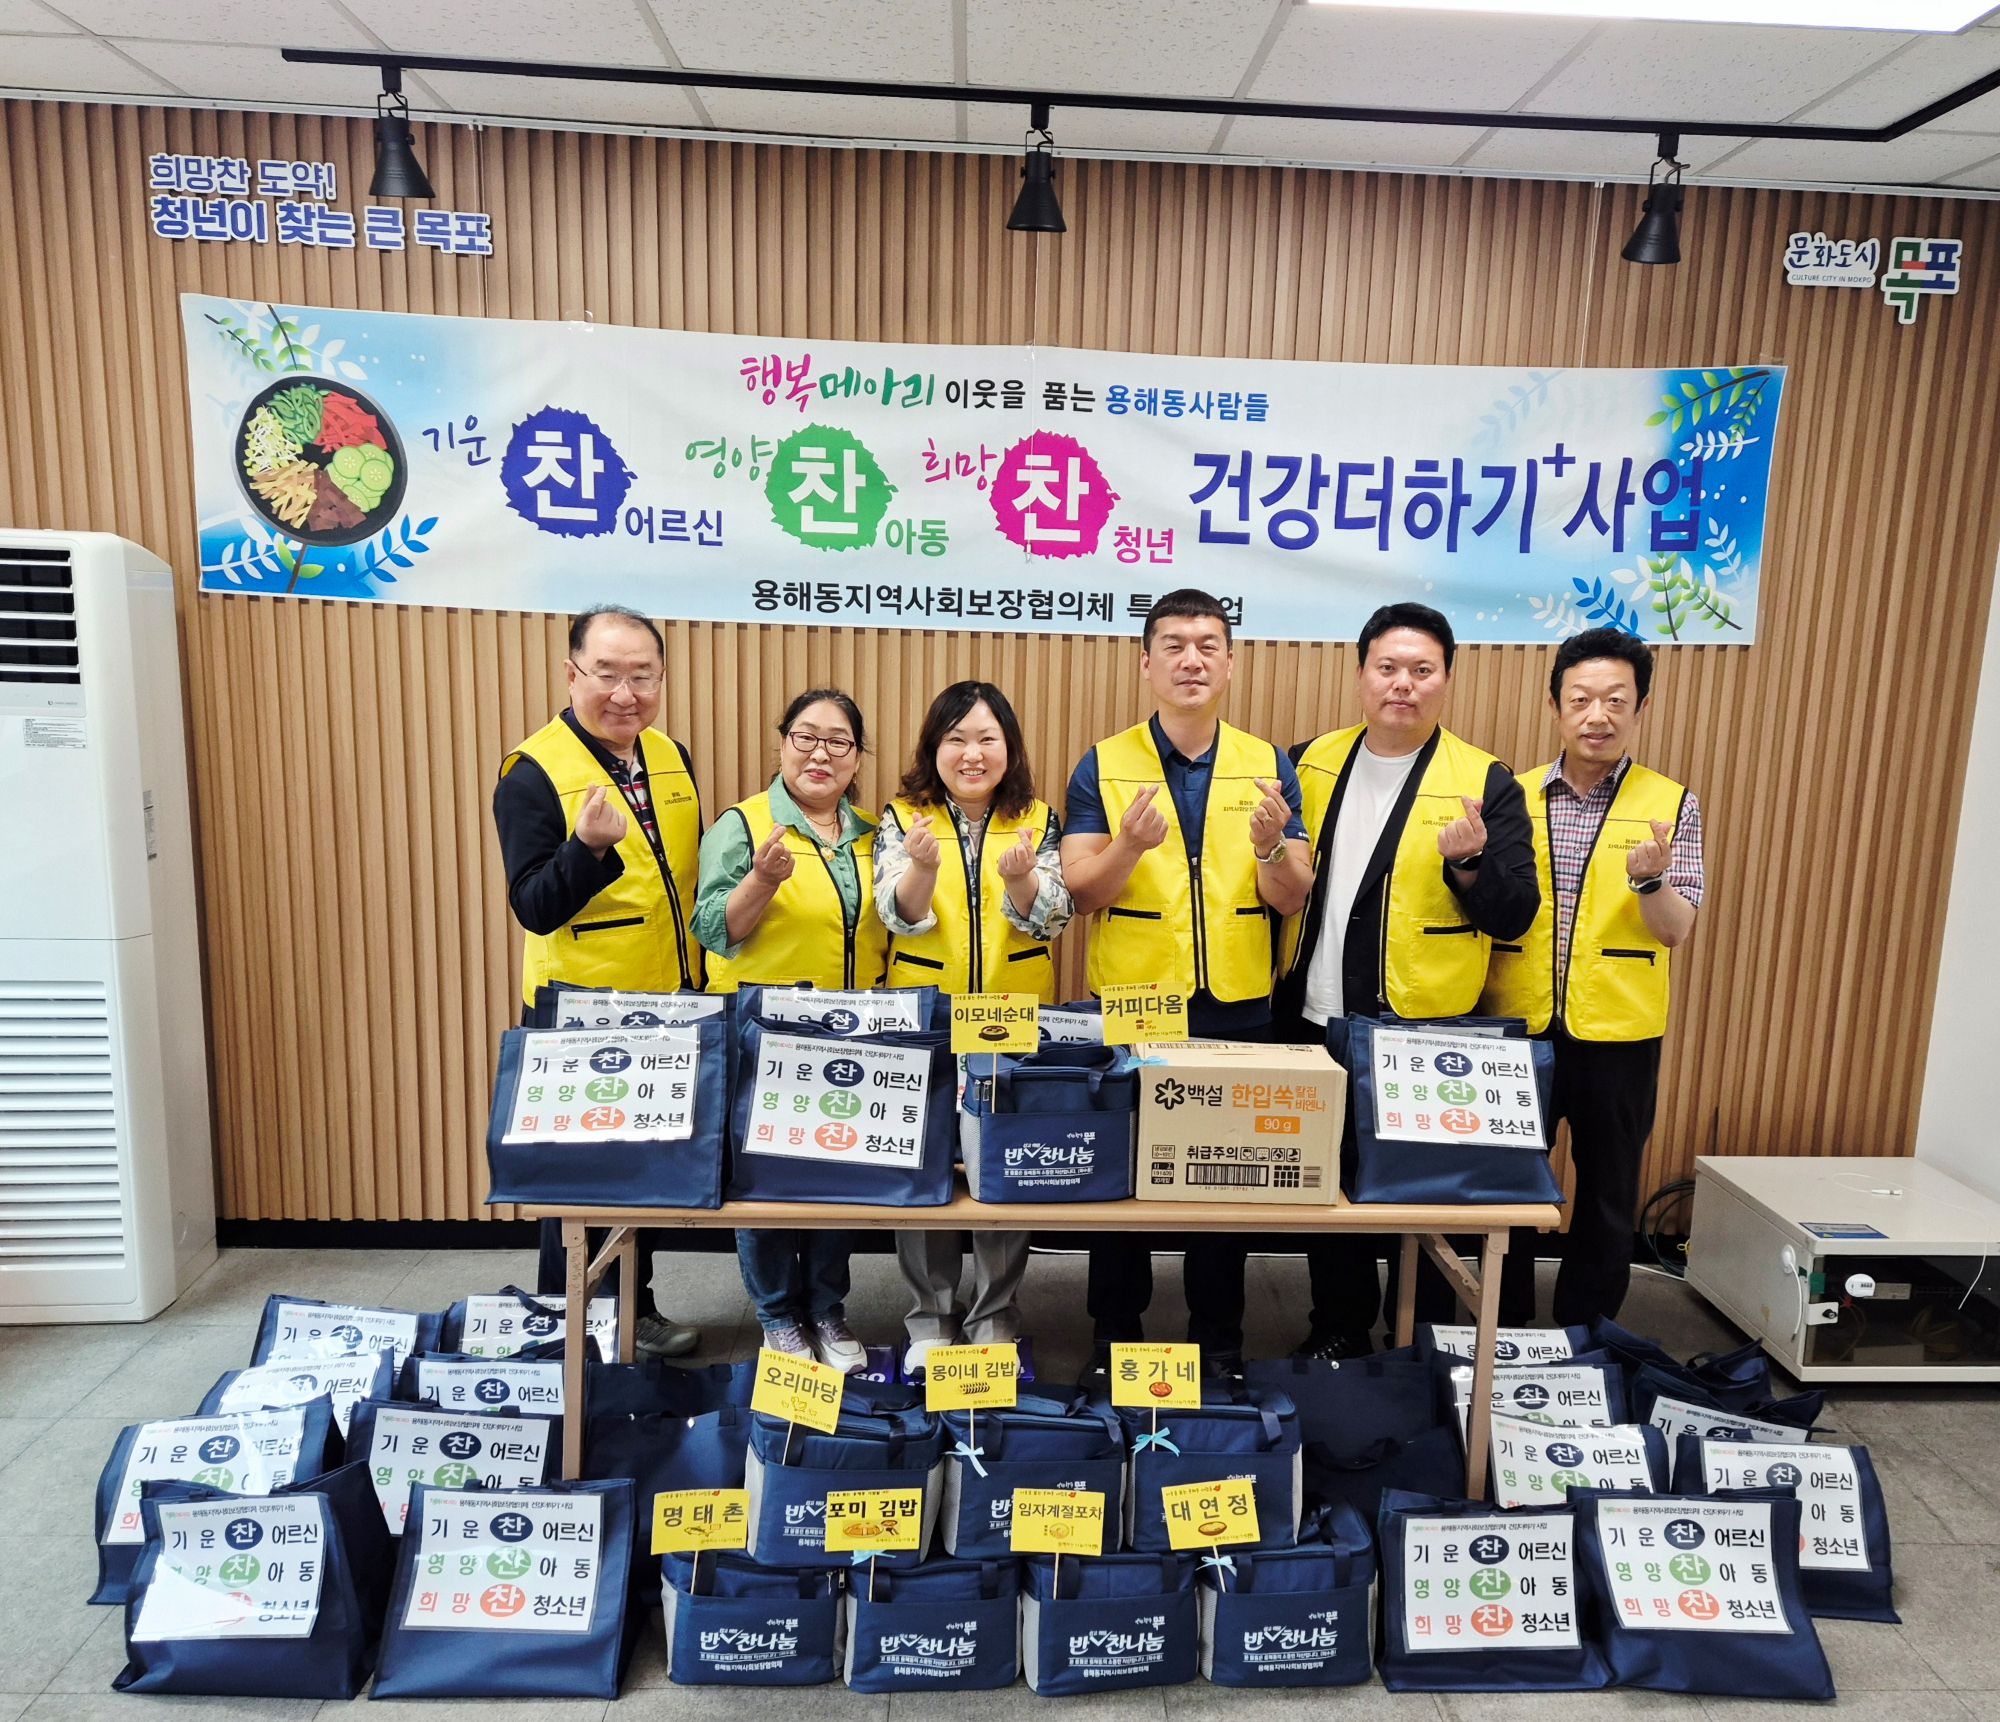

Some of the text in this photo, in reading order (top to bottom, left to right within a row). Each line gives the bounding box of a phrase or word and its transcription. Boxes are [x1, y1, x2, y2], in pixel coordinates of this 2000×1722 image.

[150, 154, 334, 198] 희망찬 도약!
[152, 197, 492, 255] 청년이 찾는 큰 목포
[1788, 236, 1876, 271] 문화도시
[1791, 274, 1873, 284] CULTURE CITY IN MOKPO
[1885, 241, 1959, 320] 목포
[945, 378, 1026, 411] 이웃을
[1041, 381, 1096, 413] 품는
[1105, 384, 1270, 423] 용해동사람들
[422, 415, 492, 467] 기운
[521, 429, 605, 522] 찬
[624, 506, 724, 548] 어르신
[685, 434, 775, 480] 영양
[786, 447, 867, 535] 찬
[885, 517, 950, 557] 아동
[921, 438, 999, 490] 희망
[1010, 453, 1091, 542] 찬
[1112, 525, 1175, 564] 청년
[751, 579, 1115, 624] 용해동지역사회보장협의체
[954, 1006, 1034, 1023] 이모네순대
[1105, 994, 1184, 1018] 커피다옴
[531, 1050, 690, 1073] 기 운 찬 어르신
[1383, 1055, 1528, 1079] 기 운 찬 어르신
[766, 1061, 922, 1091] 기 운 찬 어르신
[527, 1078, 686, 1102] 영 양 찬 아 동
[1188, 1084, 1223, 1107] 백설
[1231, 1083, 1295, 1110] 한입쏙
[1384, 1082, 1532, 1107] 영 양 찬 아 동
[521, 1108, 684, 1131] 희 망 찬 청소년
[762, 1092, 918, 1123] 영 양 찬 아 동
[1263, 1118, 1280, 1131] 90
[1386, 1110, 1536, 1136] 희 망 찬 청소년
[756, 1124, 914, 1155] 희 망 찬 청소년
[1186, 1145, 1239, 1160] 취급주의
[763, 1365, 839, 1404] 오리마당
[931, 1361, 1016, 1382] 몽이네 김밥
[1715, 1467, 1853, 1490] 기 운 찬 어르신
[827, 1498, 918, 1519] 포미 김밥
[1018, 1501, 1103, 1521] 임자계절포차
[172, 1522, 318, 1550] 기 운 찬 어르신
[431, 1517, 594, 1542] 기 운 찬 어르신
[1609, 1524, 1765, 1548] 기 운 찬 어르신
[1414, 1539, 1566, 1563] 기 운 찬 어르신
[1813, 1536, 1859, 1556] 청소년
[428, 1549, 591, 1578] 영 양 찬 아 동
[1616, 1556, 1768, 1583] 영 양 찬 아 동
[1414, 1571, 1568, 1599] 영 양 찬 아 동
[418, 1586, 586, 1616] 희 망 찬 청소년
[1624, 1592, 1777, 1619] 희 망 찬 청소년
[1415, 1607, 1570, 1635] 희 망 찬 청소년
